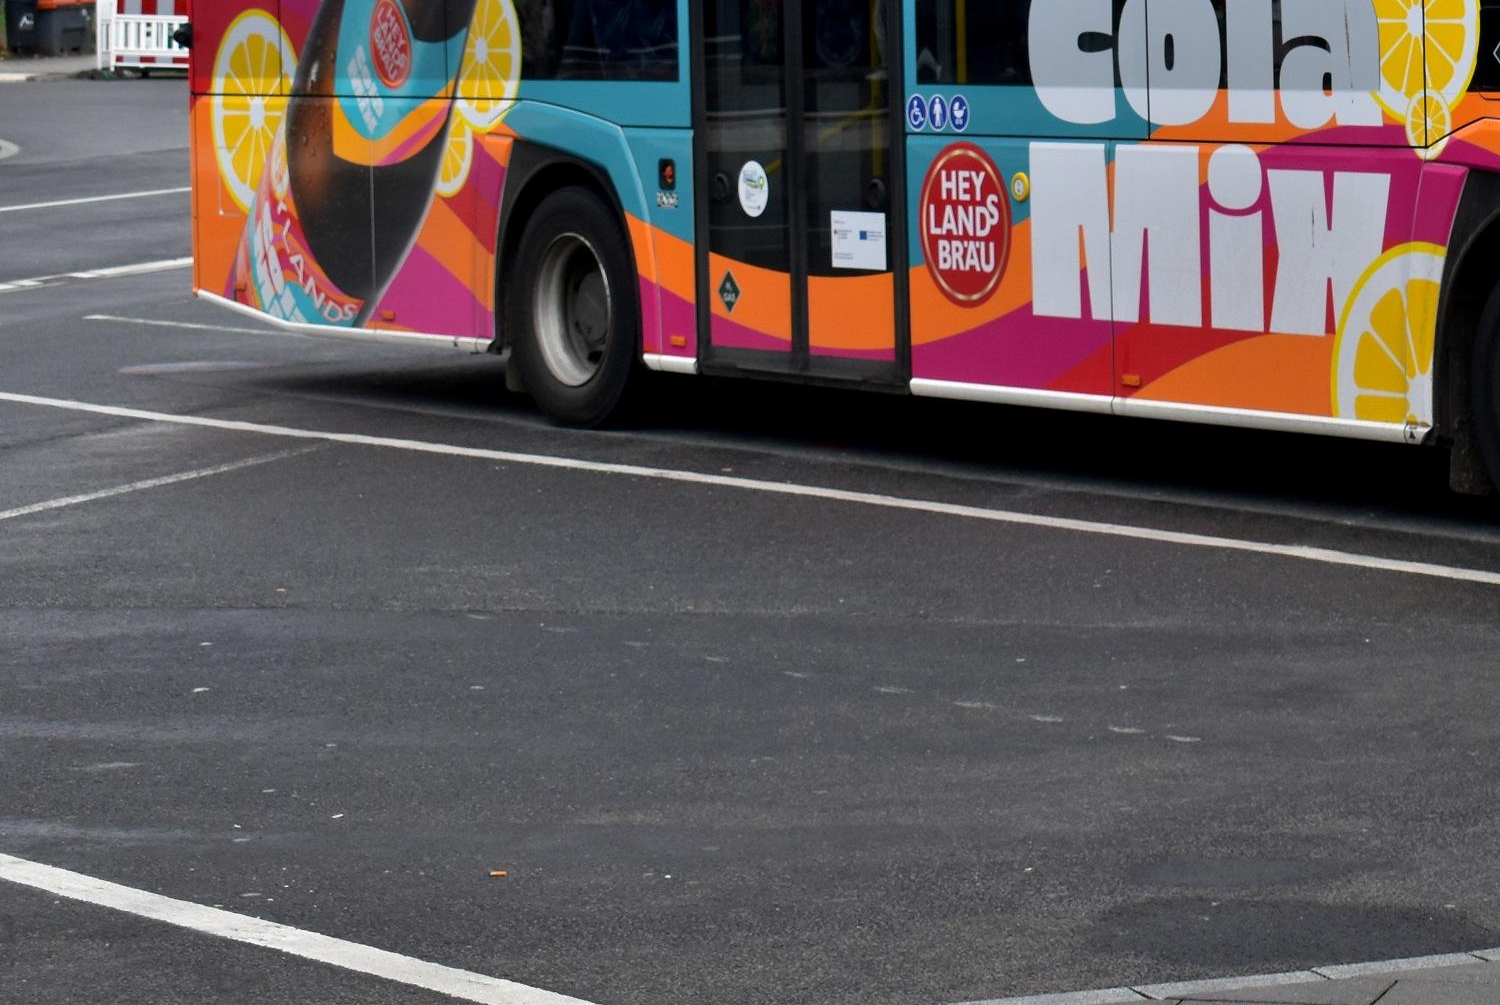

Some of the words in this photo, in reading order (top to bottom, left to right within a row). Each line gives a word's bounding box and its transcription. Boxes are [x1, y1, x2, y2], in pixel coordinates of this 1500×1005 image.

[940, 169, 986, 202] HEY
[929, 193, 1000, 238] LANDS
[937, 239, 996, 274] BRÄU
